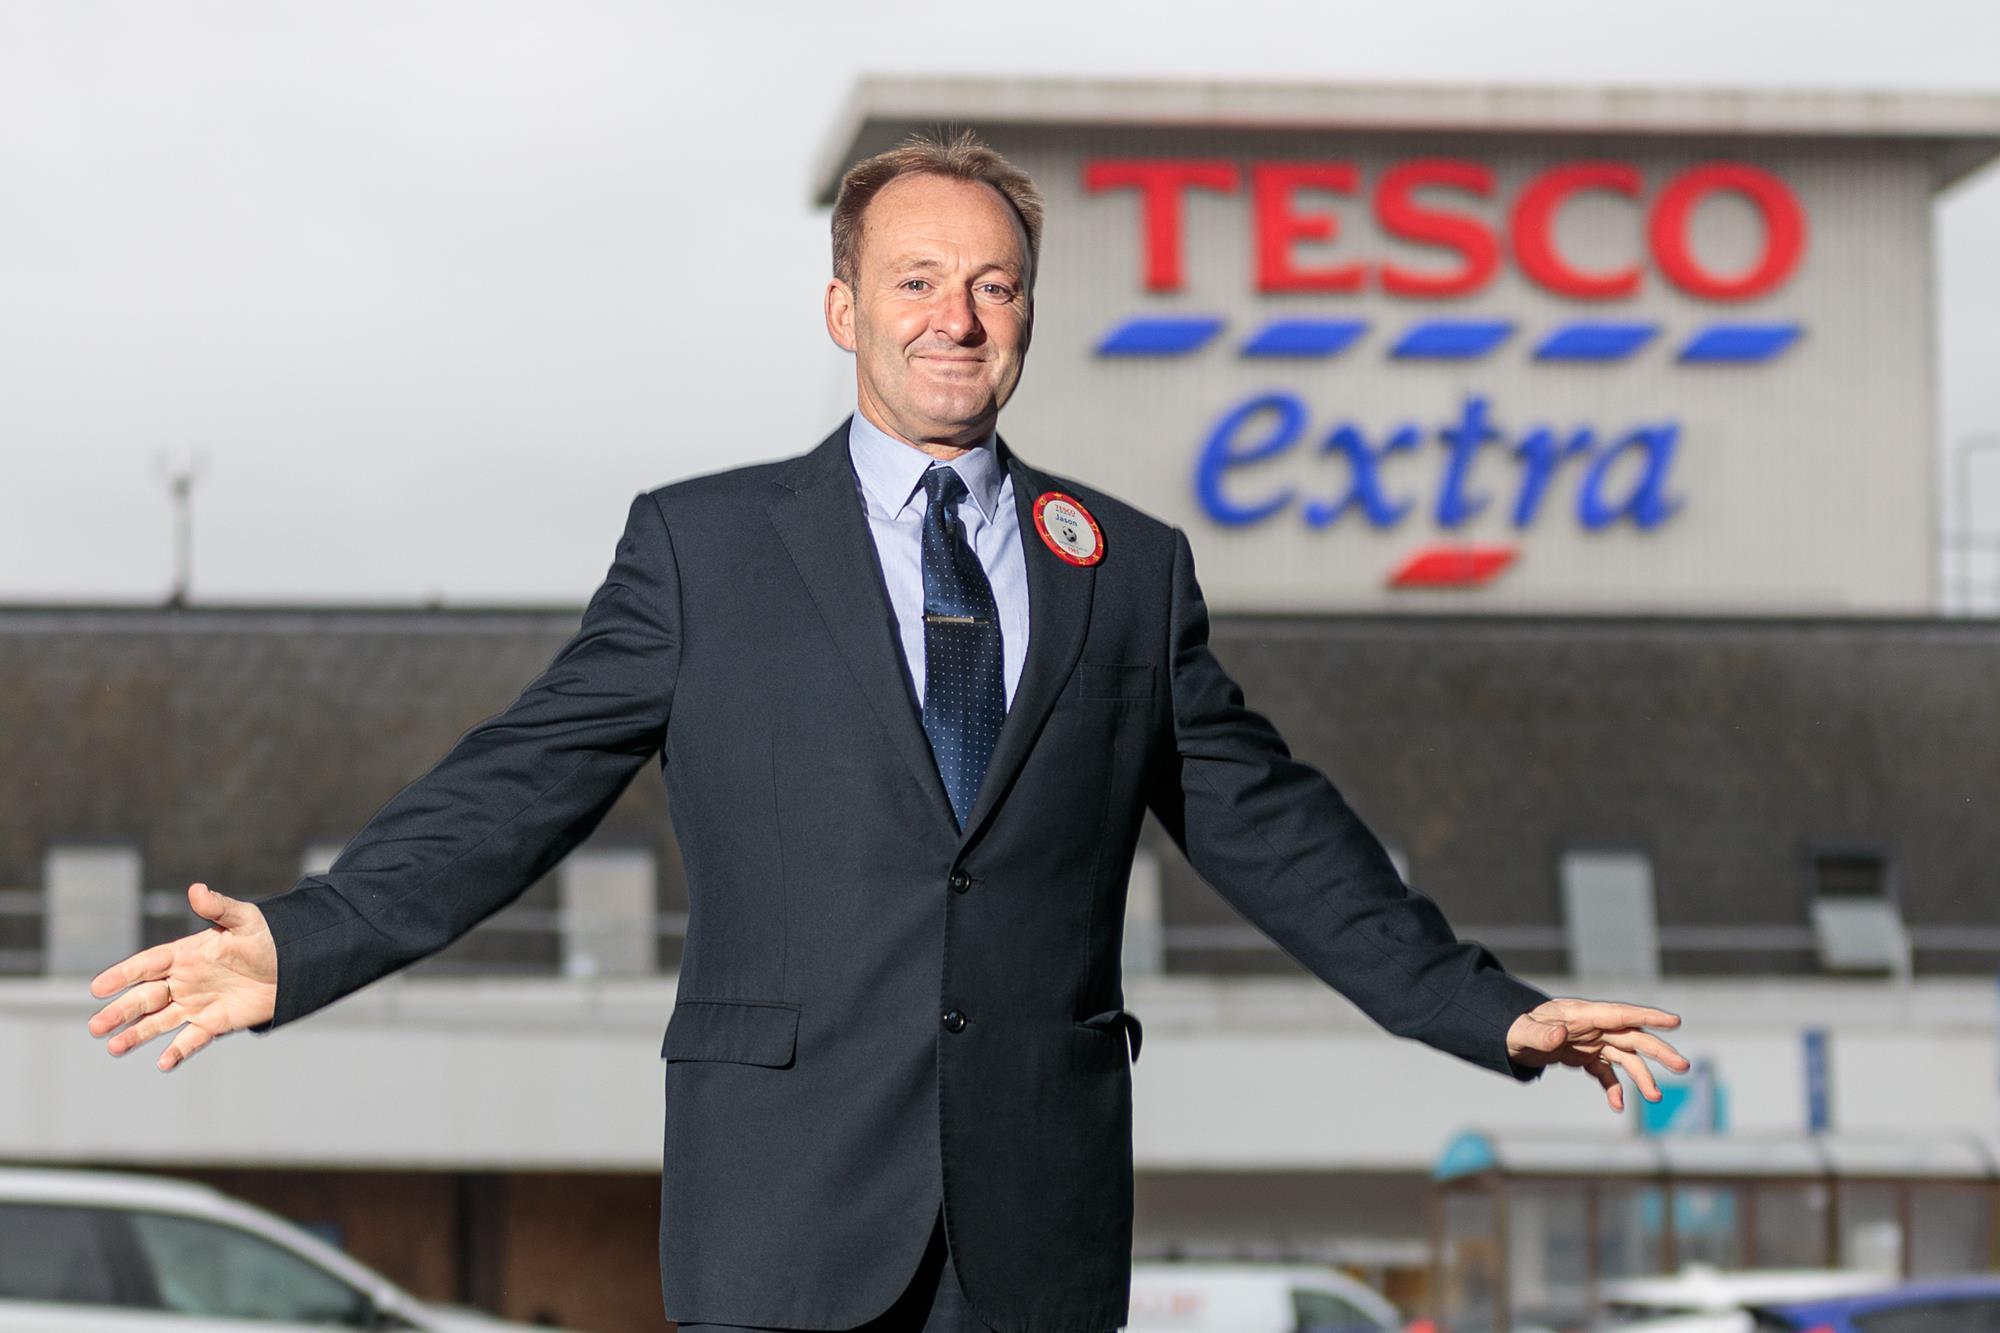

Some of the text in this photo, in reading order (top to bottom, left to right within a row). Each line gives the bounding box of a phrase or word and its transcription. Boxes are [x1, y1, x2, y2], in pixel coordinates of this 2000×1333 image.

[1084, 159, 1808, 303] TESCO
[1056, 514, 1078, 527] Jason
[1193, 391, 1683, 531] extra
